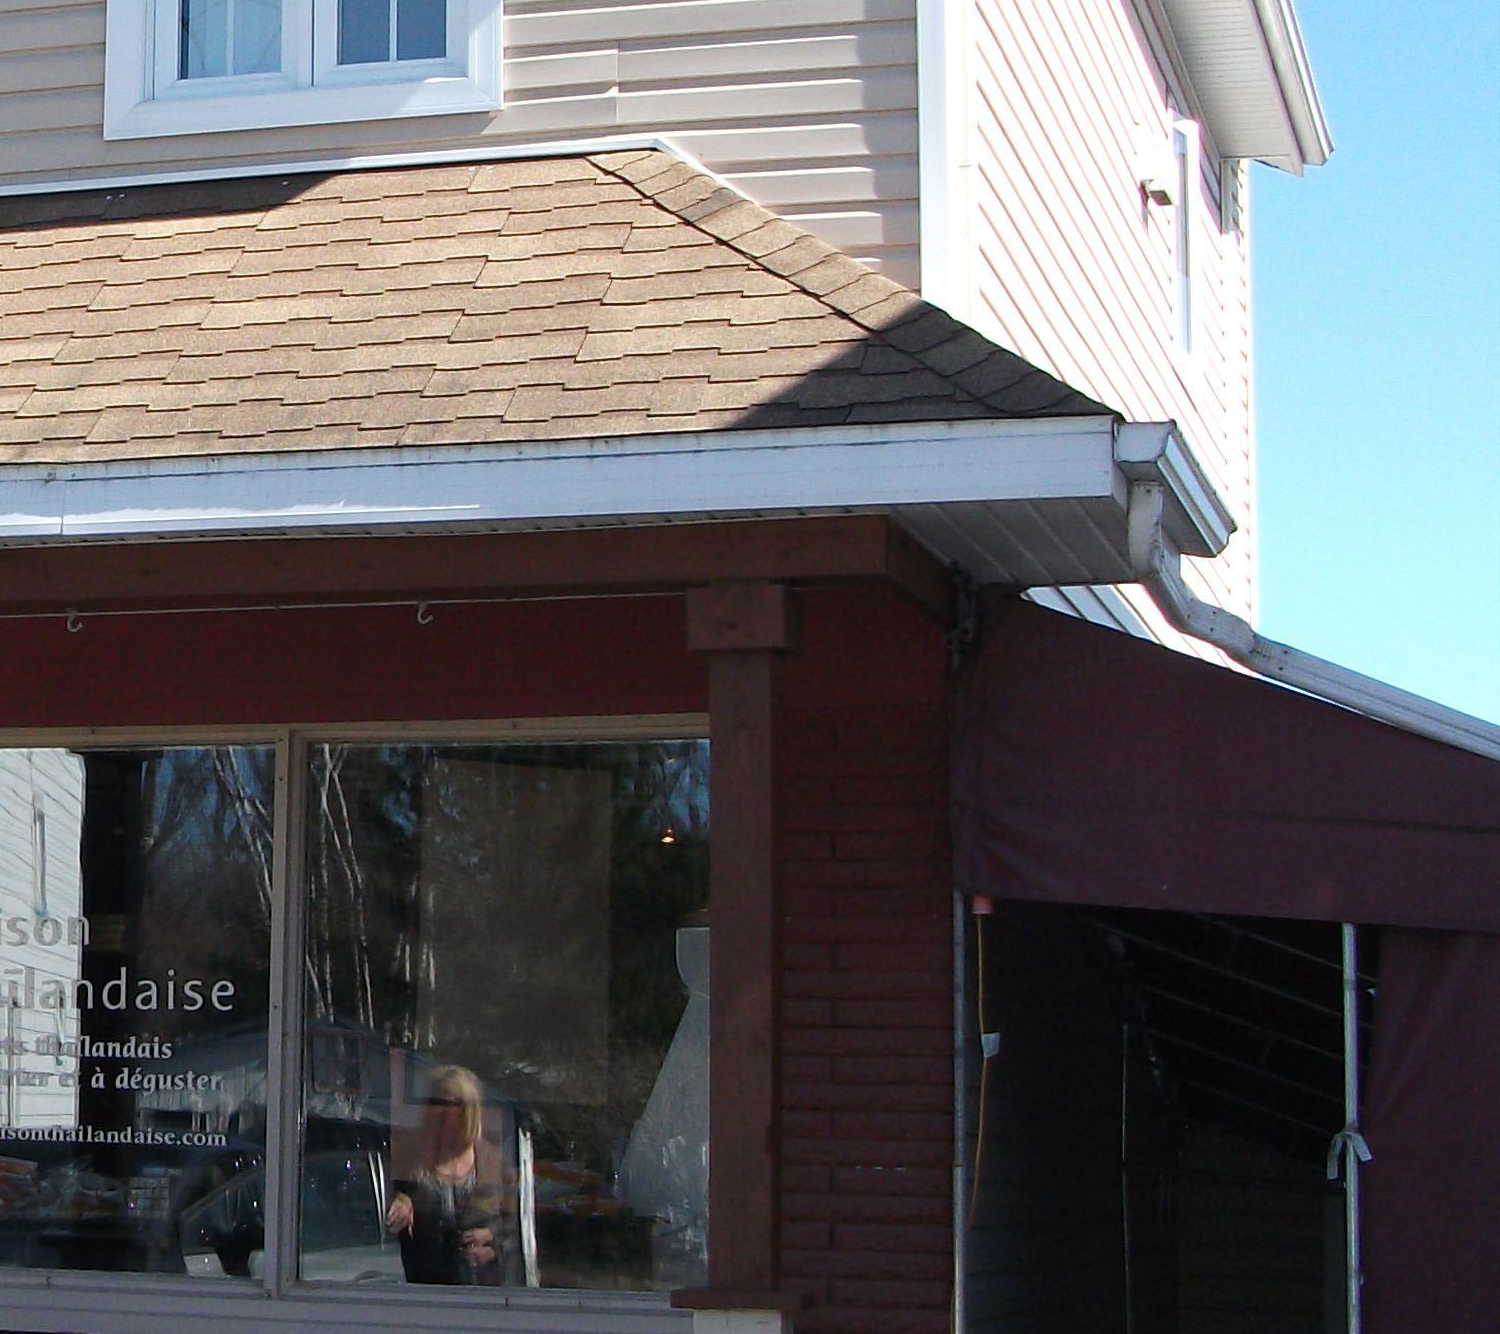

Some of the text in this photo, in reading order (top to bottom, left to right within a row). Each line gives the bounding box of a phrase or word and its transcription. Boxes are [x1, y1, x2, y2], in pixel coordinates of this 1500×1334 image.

[36, 1034, 172, 1059] thaïlandais
[58, 1067, 82, 1088] et
[91, 1066, 106, 1089] à
[115, 1067, 222, 1095] déguster
